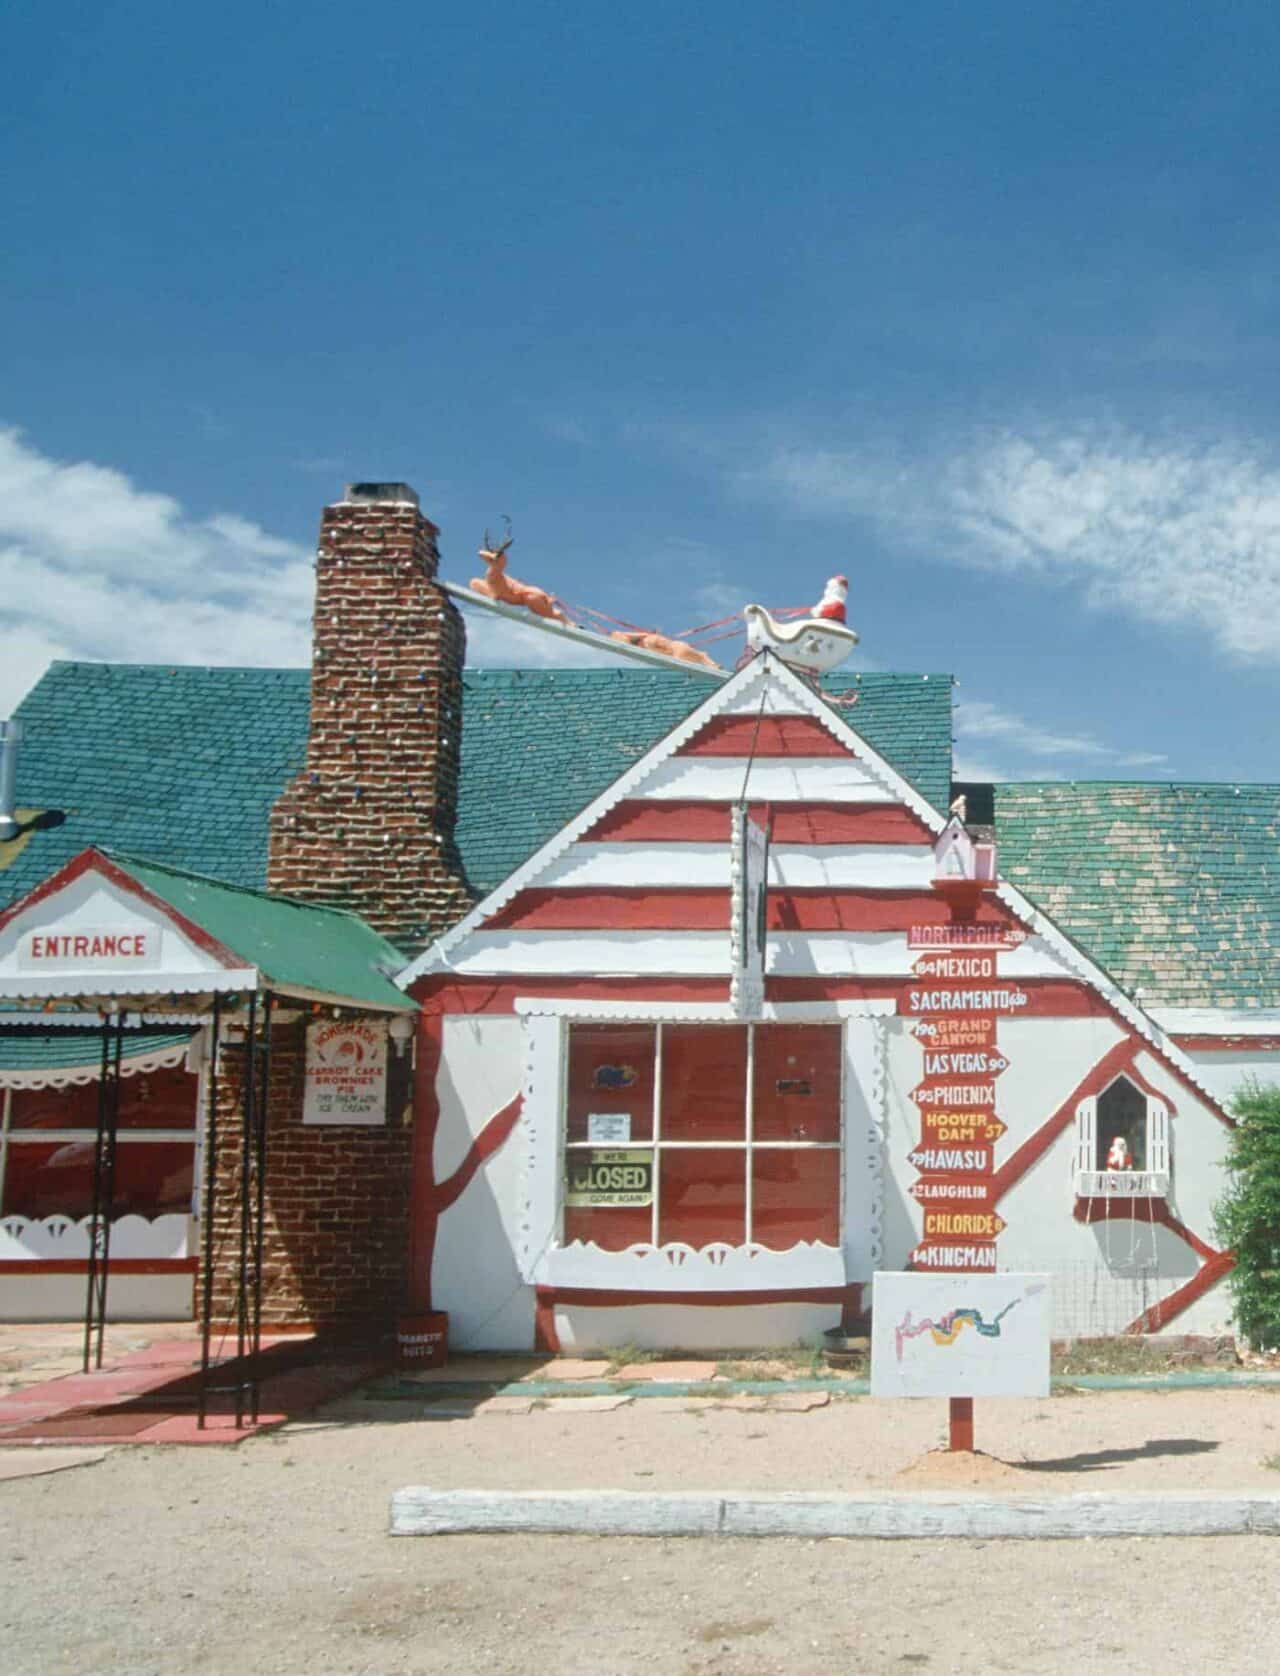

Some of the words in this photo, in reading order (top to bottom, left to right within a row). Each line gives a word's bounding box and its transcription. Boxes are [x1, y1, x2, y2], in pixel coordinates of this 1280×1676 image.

[911, 926, 965, 945] NORTH
[967, 926, 1001, 945] POLE
[31, 935, 146, 957] ENTRANCE
[936, 958, 992, 978] MEXICO
[910, 989, 1009, 1011] SACRAMENTO
[938, 1019, 992, 1034] GRAND
[930, 1035, 987, 1046] CANYON
[926, 1055, 949, 1074] LAS
[950, 1053, 988, 1073] VEGAS
[989, 1060, 1007, 1071] 90
[934, 1086, 994, 1105] PHOENIX
[926, 1114, 986, 1127] HOOVER
[938, 1128, 975, 1141] DAM
[984, 1125, 1003, 1138] 57
[924, 1150, 986, 1170] HAVASU
[924, 1186, 987, 1198] LAUGHLIN
[926, 1214, 994, 1233] CHLORIDE
[928, 1247, 995, 1267] KINGMAN
